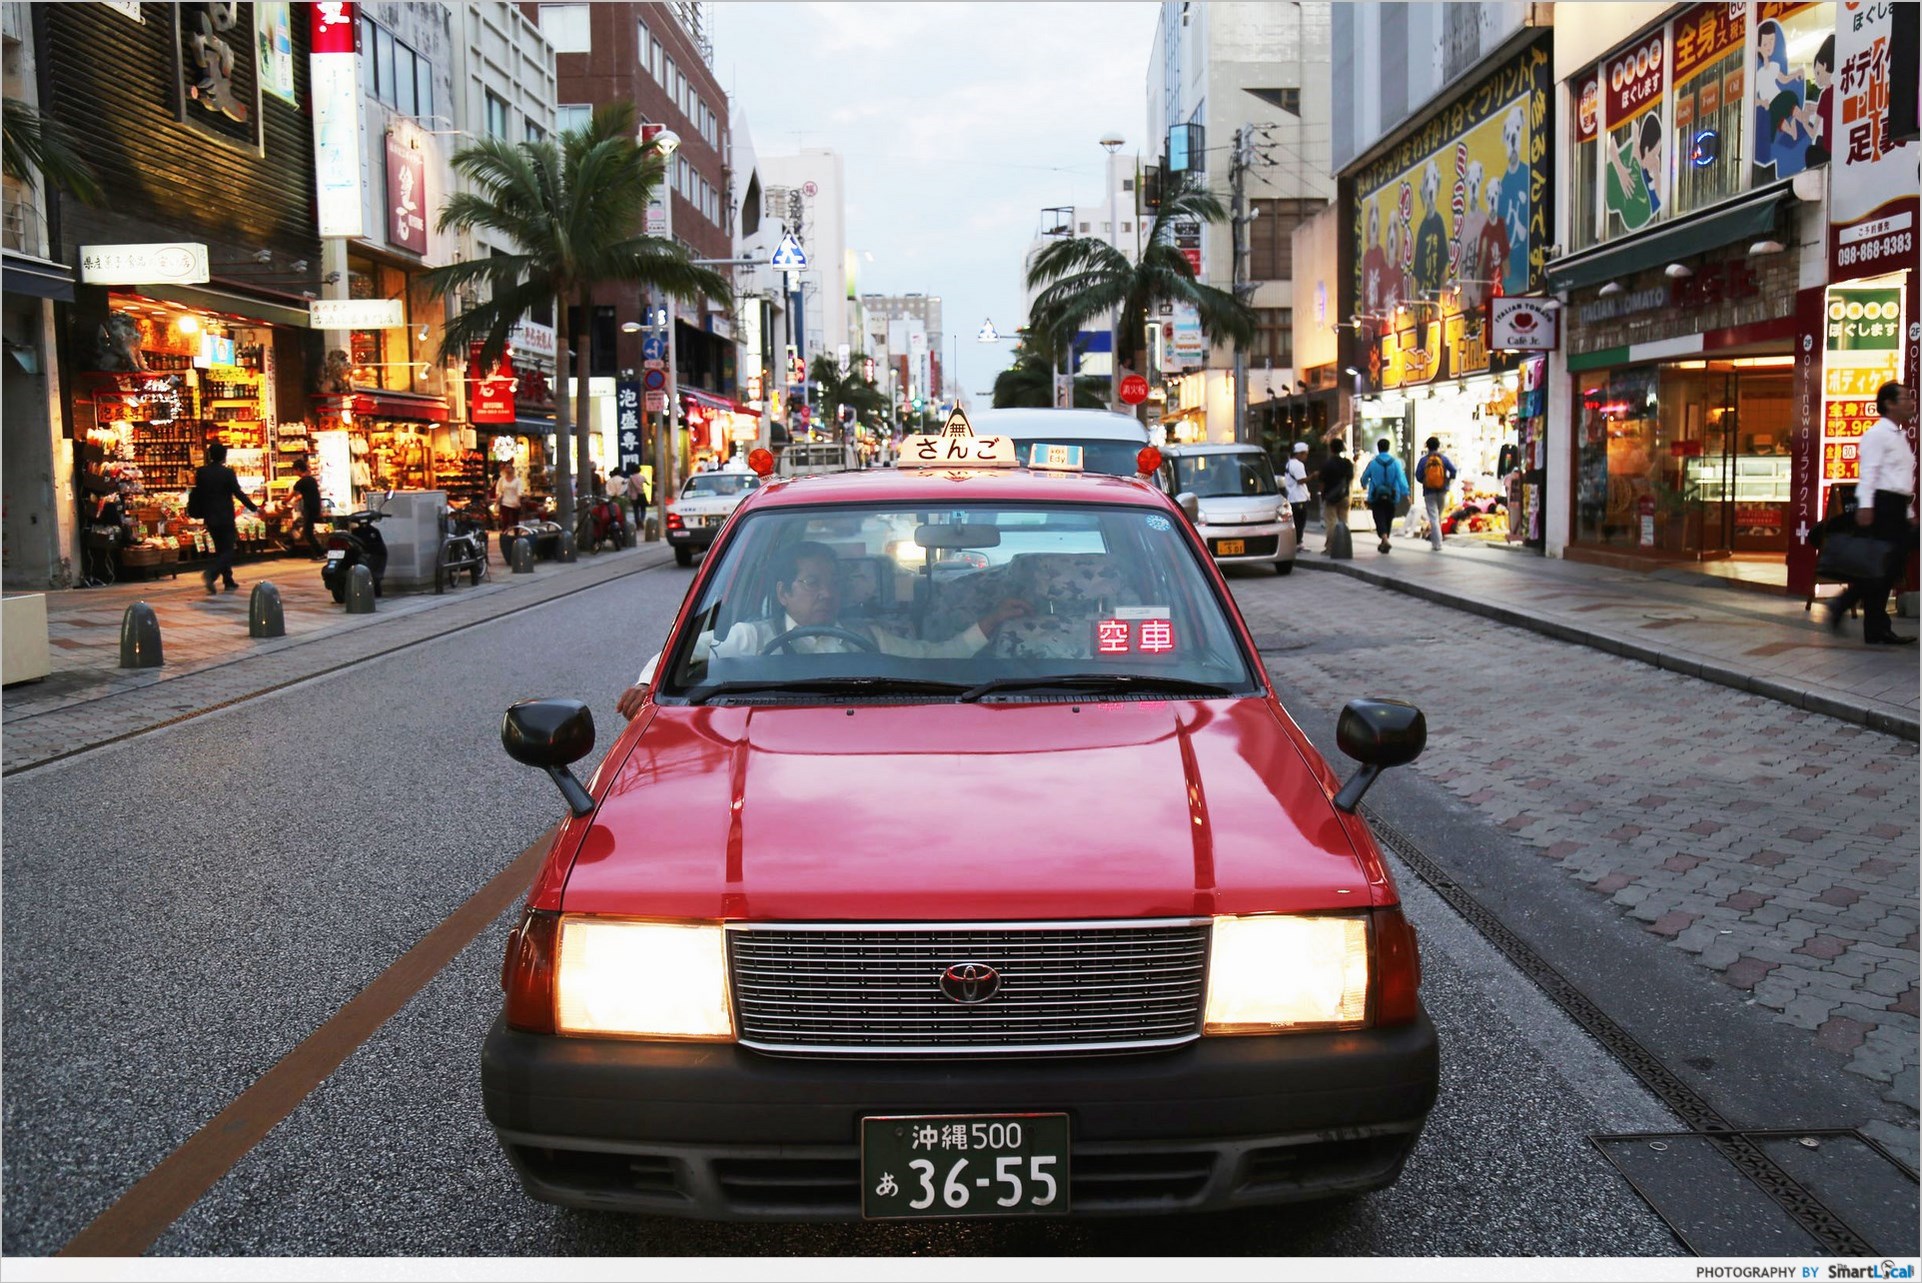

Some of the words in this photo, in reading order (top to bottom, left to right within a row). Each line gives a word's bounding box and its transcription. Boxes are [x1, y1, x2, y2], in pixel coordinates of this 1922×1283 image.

[1676, 10, 1717, 71] 全身
[1621, 72, 1660, 108] ほぐします
[1838, 232, 1912, 267] 098-868-9383
[1495, 304, 1523, 324] ITALIAN
[1507, 336, 1527, 346] Café
[1828, 322, 1898, 338] ほぐします
[1828, 401, 1859, 418] 全身
[619, 388, 639, 474] 泡盛専門
[949, 422, 967, 438] 無
[916, 437, 1000, 461] さんご
[1049, 454, 1067, 465] Edy
[1100, 620, 1173, 653] 空車
[875, 1171, 900, 1198] あ
[908, 1155, 1058, 1210] 36-55
